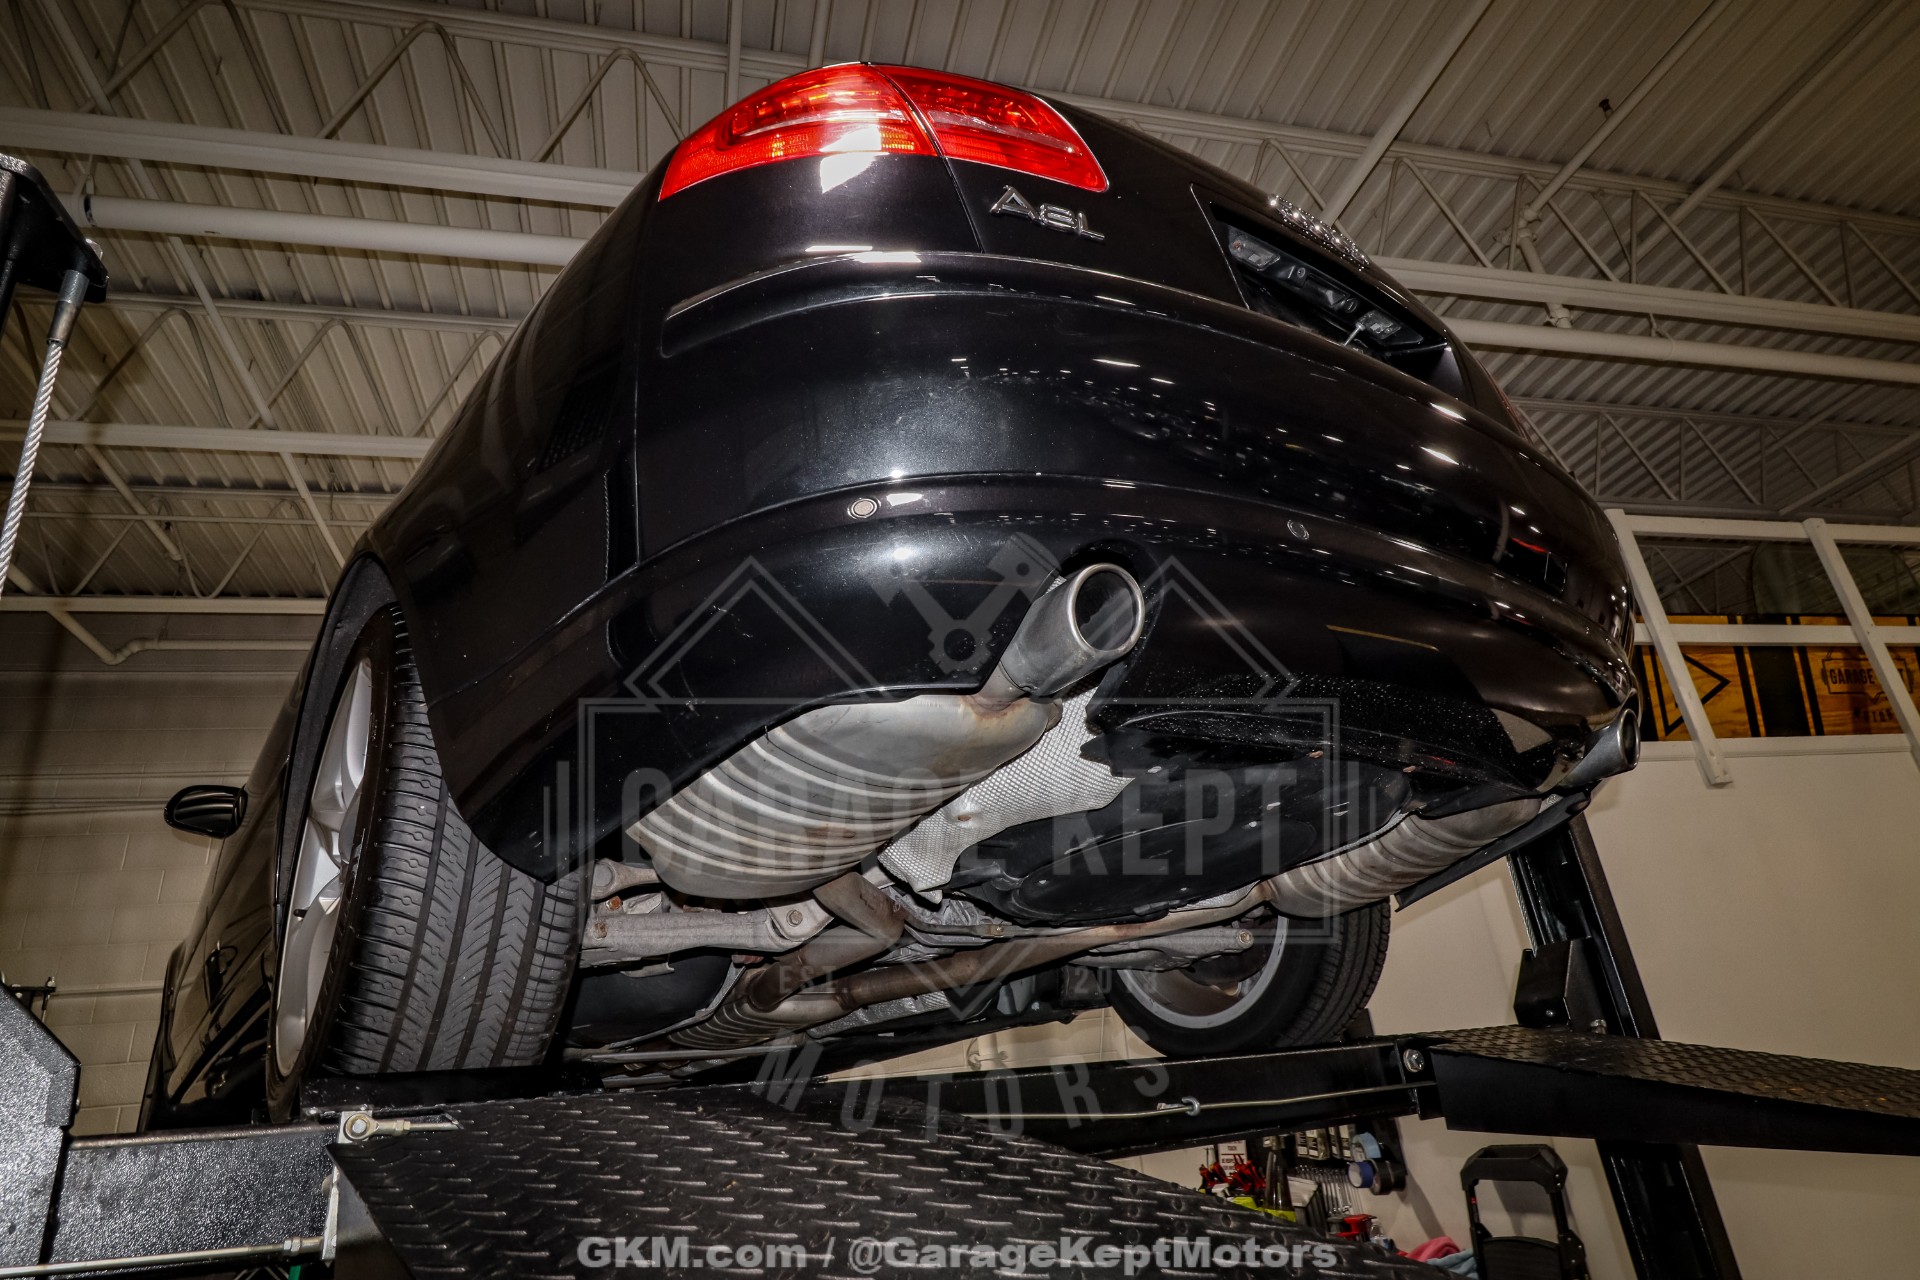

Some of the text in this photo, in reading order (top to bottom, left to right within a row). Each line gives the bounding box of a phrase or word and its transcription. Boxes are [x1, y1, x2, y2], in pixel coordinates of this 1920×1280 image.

[990, 185, 1105, 241] A8L
[1829, 668, 1876, 685] GARAGE
[1853, 706, 1894, 723] MOTOR
